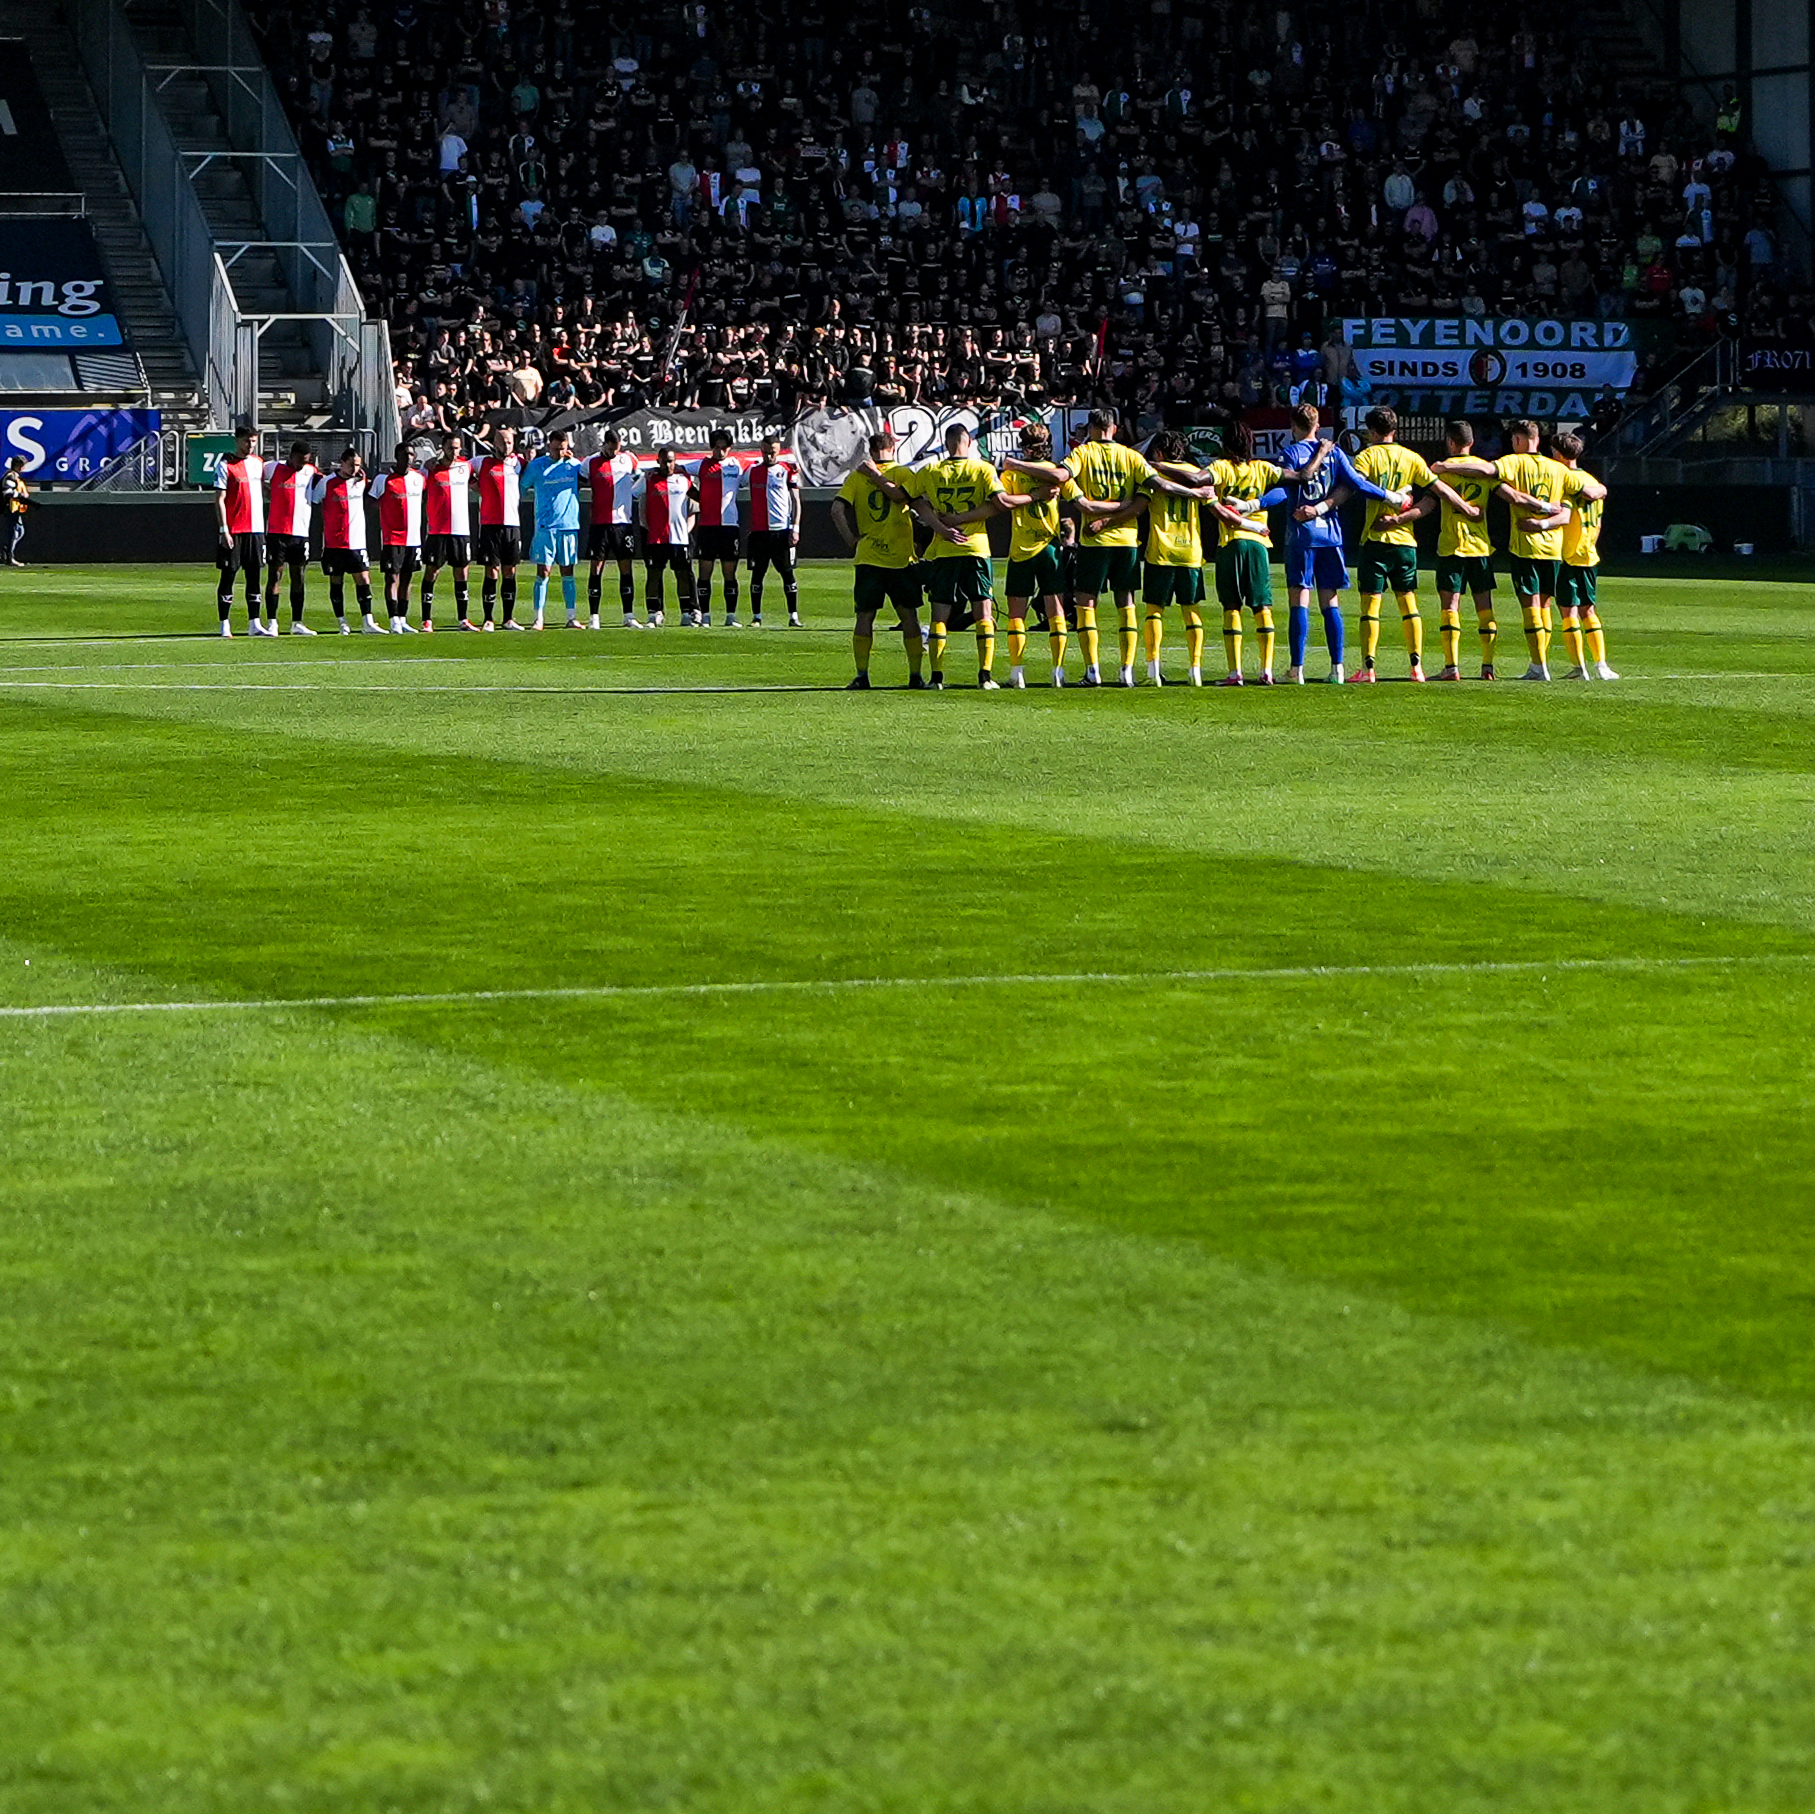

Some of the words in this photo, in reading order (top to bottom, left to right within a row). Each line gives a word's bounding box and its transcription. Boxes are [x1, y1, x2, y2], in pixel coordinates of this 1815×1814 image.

[1341, 318, 1631, 348] FEYENOORD
[1368, 360, 1459, 378] SINDS
[1514, 361, 1587, 379] 1908
[867, 491, 891, 522] 9
